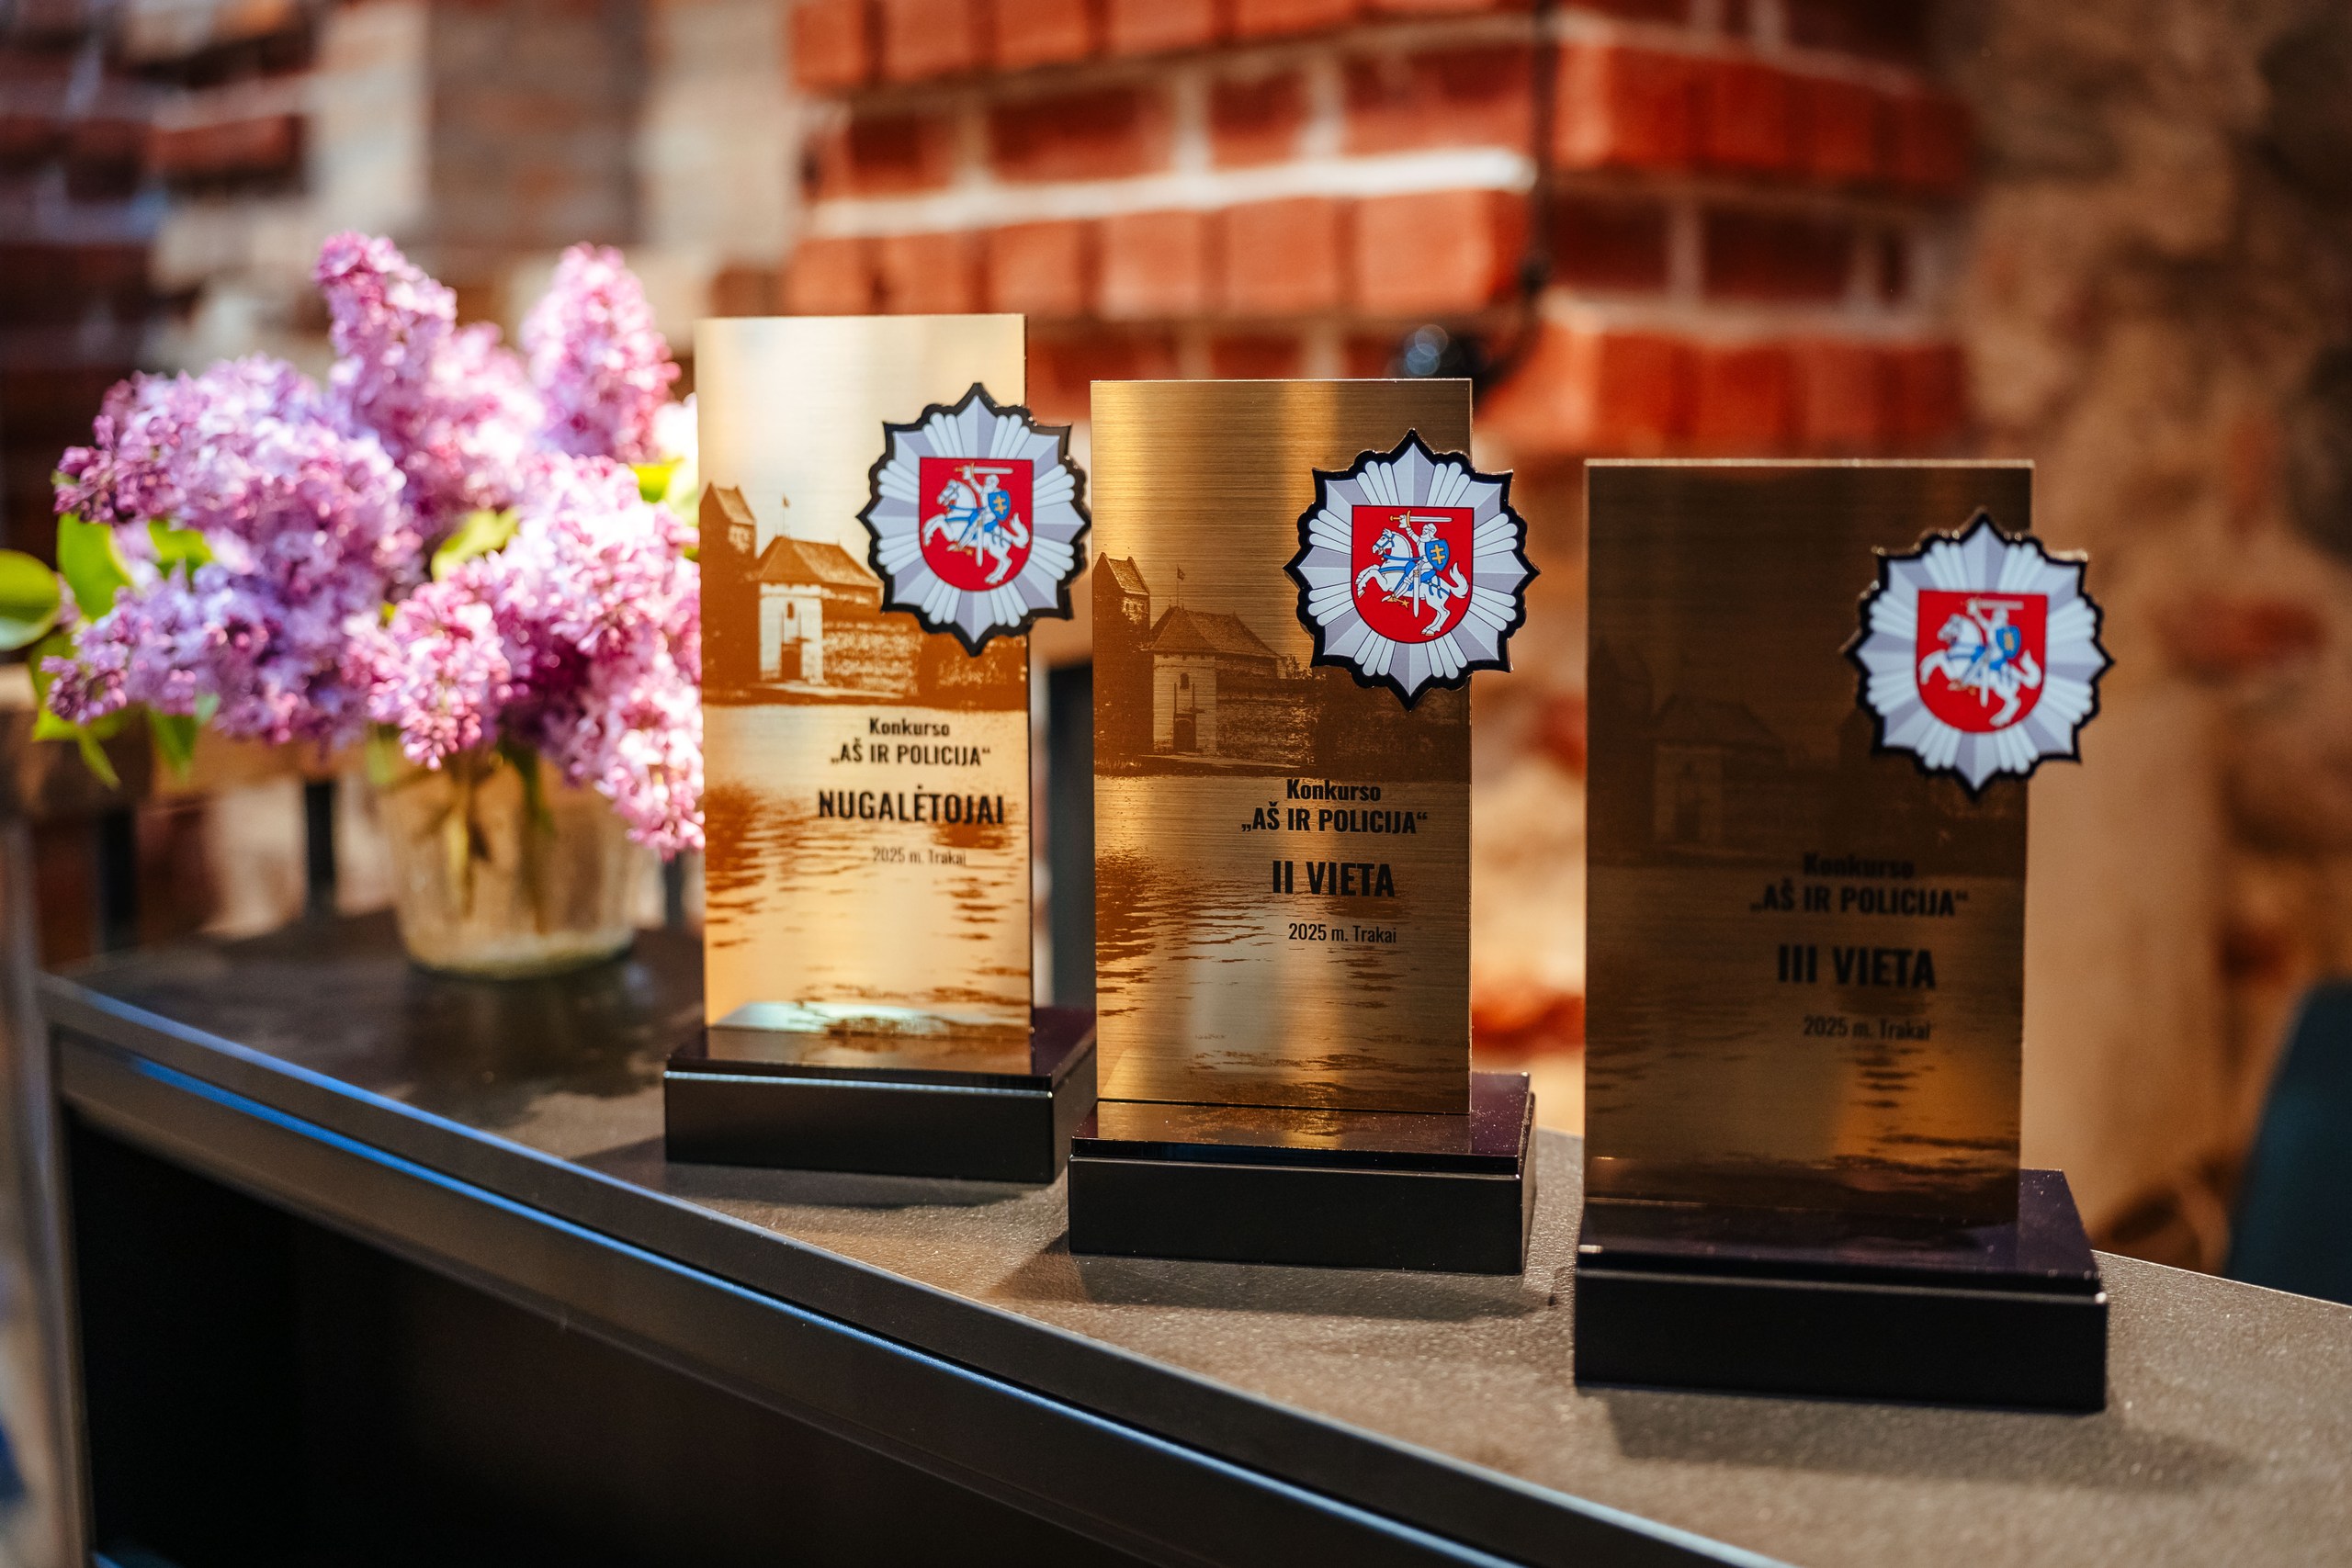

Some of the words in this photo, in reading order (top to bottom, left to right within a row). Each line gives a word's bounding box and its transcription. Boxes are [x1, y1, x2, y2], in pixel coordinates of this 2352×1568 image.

[869, 717, 950, 736] Konkurso
[831, 737, 864, 765] „AŠ
[870, 743, 889, 764] IR
[897, 744, 990, 767] POLICIJA“
[1286, 778, 1382, 802] Konkurso
[818, 784, 1004, 826] NUGALĖTOJAI
[1241, 801, 1281, 832] „AŠ
[1287, 807, 1311, 831] IR
[1318, 808, 1428, 835] POLICIJA“
[873, 845, 905, 864] 2025
[909, 851, 924, 865] m.
[928, 848, 967, 867] Trakai
[1803, 851, 1916, 879] Konkurso
[1272, 860, 1295, 894] II
[1306, 861, 1396, 897] VIETA
[1803, 885, 1832, 913] IR
[1288, 922, 1327, 942] 2025
[1331, 927, 1349, 942] m.
[1352, 925, 1397, 944] Trakai
[1778, 943, 1818, 984] III
[1831, 944, 1937, 990] VIETA
[1803, 1013, 1849, 1038] 2025
[1879, 1017, 1932, 1041] Trakai
